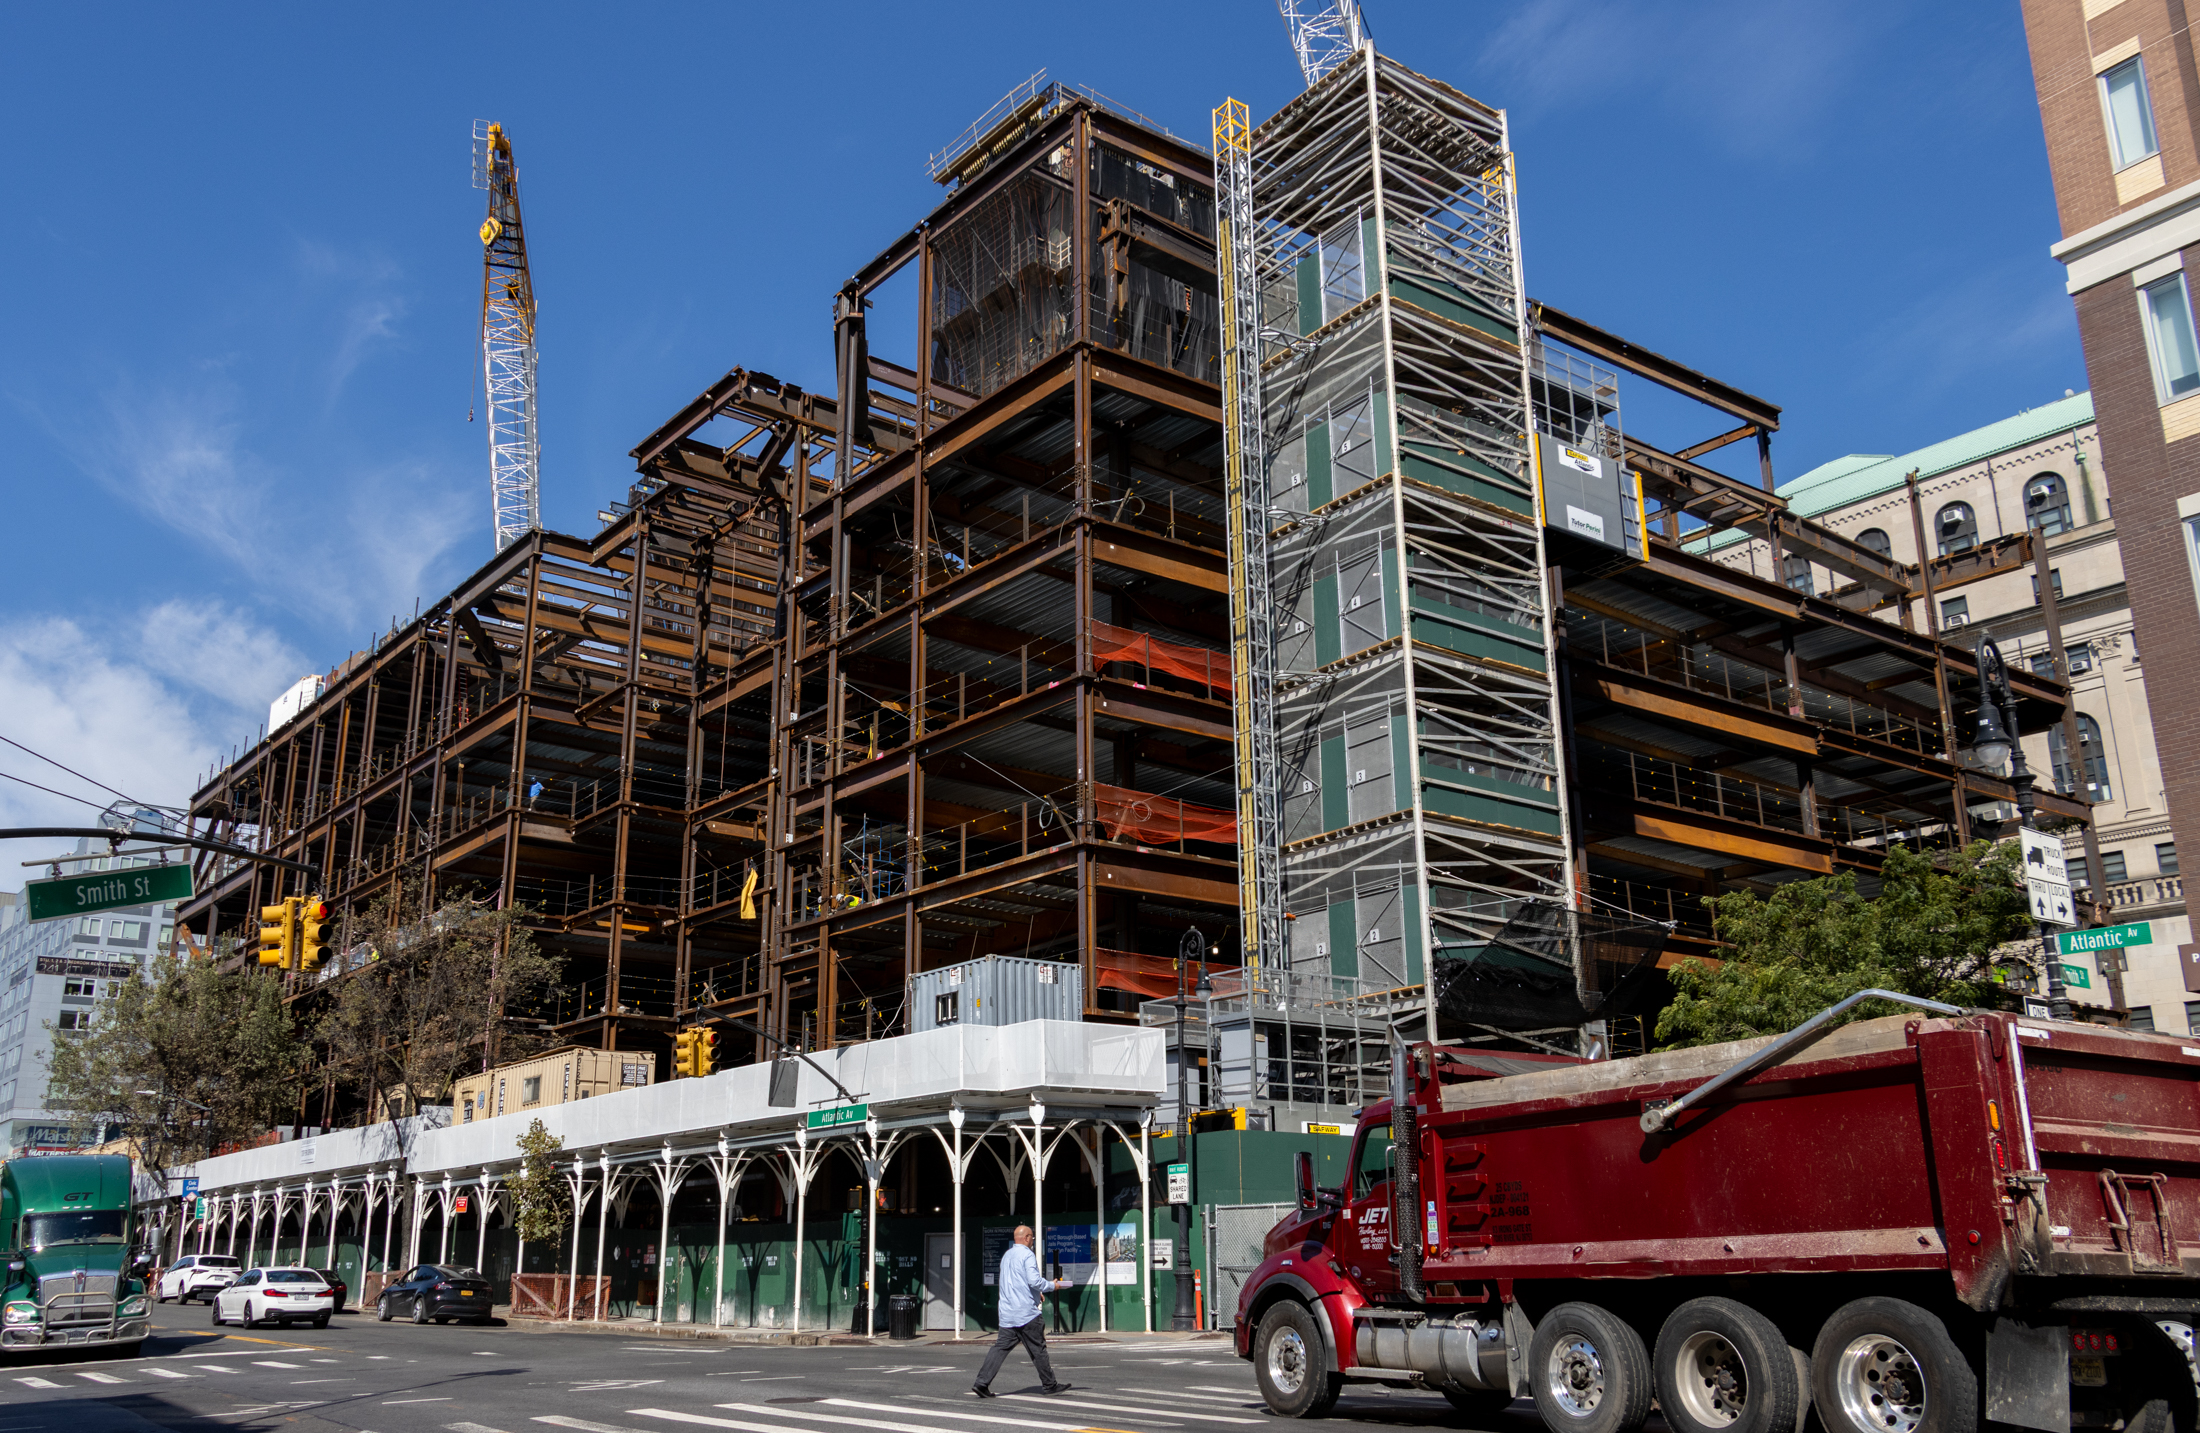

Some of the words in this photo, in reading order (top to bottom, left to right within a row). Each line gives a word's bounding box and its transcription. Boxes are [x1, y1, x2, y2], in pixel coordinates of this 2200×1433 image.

[1574, 459, 1595, 471] Atlantic
[2043, 846, 2062, 860] TRUCK
[2046, 864, 2065, 878] ROUTE
[76, 878, 127, 905] Smith
[134, 876, 151, 897] St
[2031, 880, 2046, 894] THRU
[2051, 883, 2070, 899] LOCAL
[2070, 930, 2123, 951] Atlantic
[2127, 927, 2138, 938] Av
[2032, 1006, 2046, 1018] ONE
[845, 1110, 854, 1120] Av
[63, 1192, 94, 1202] GT
[1358, 1206, 1389, 1224] JET
[1490, 1205, 1530, 1218] 2A-968
